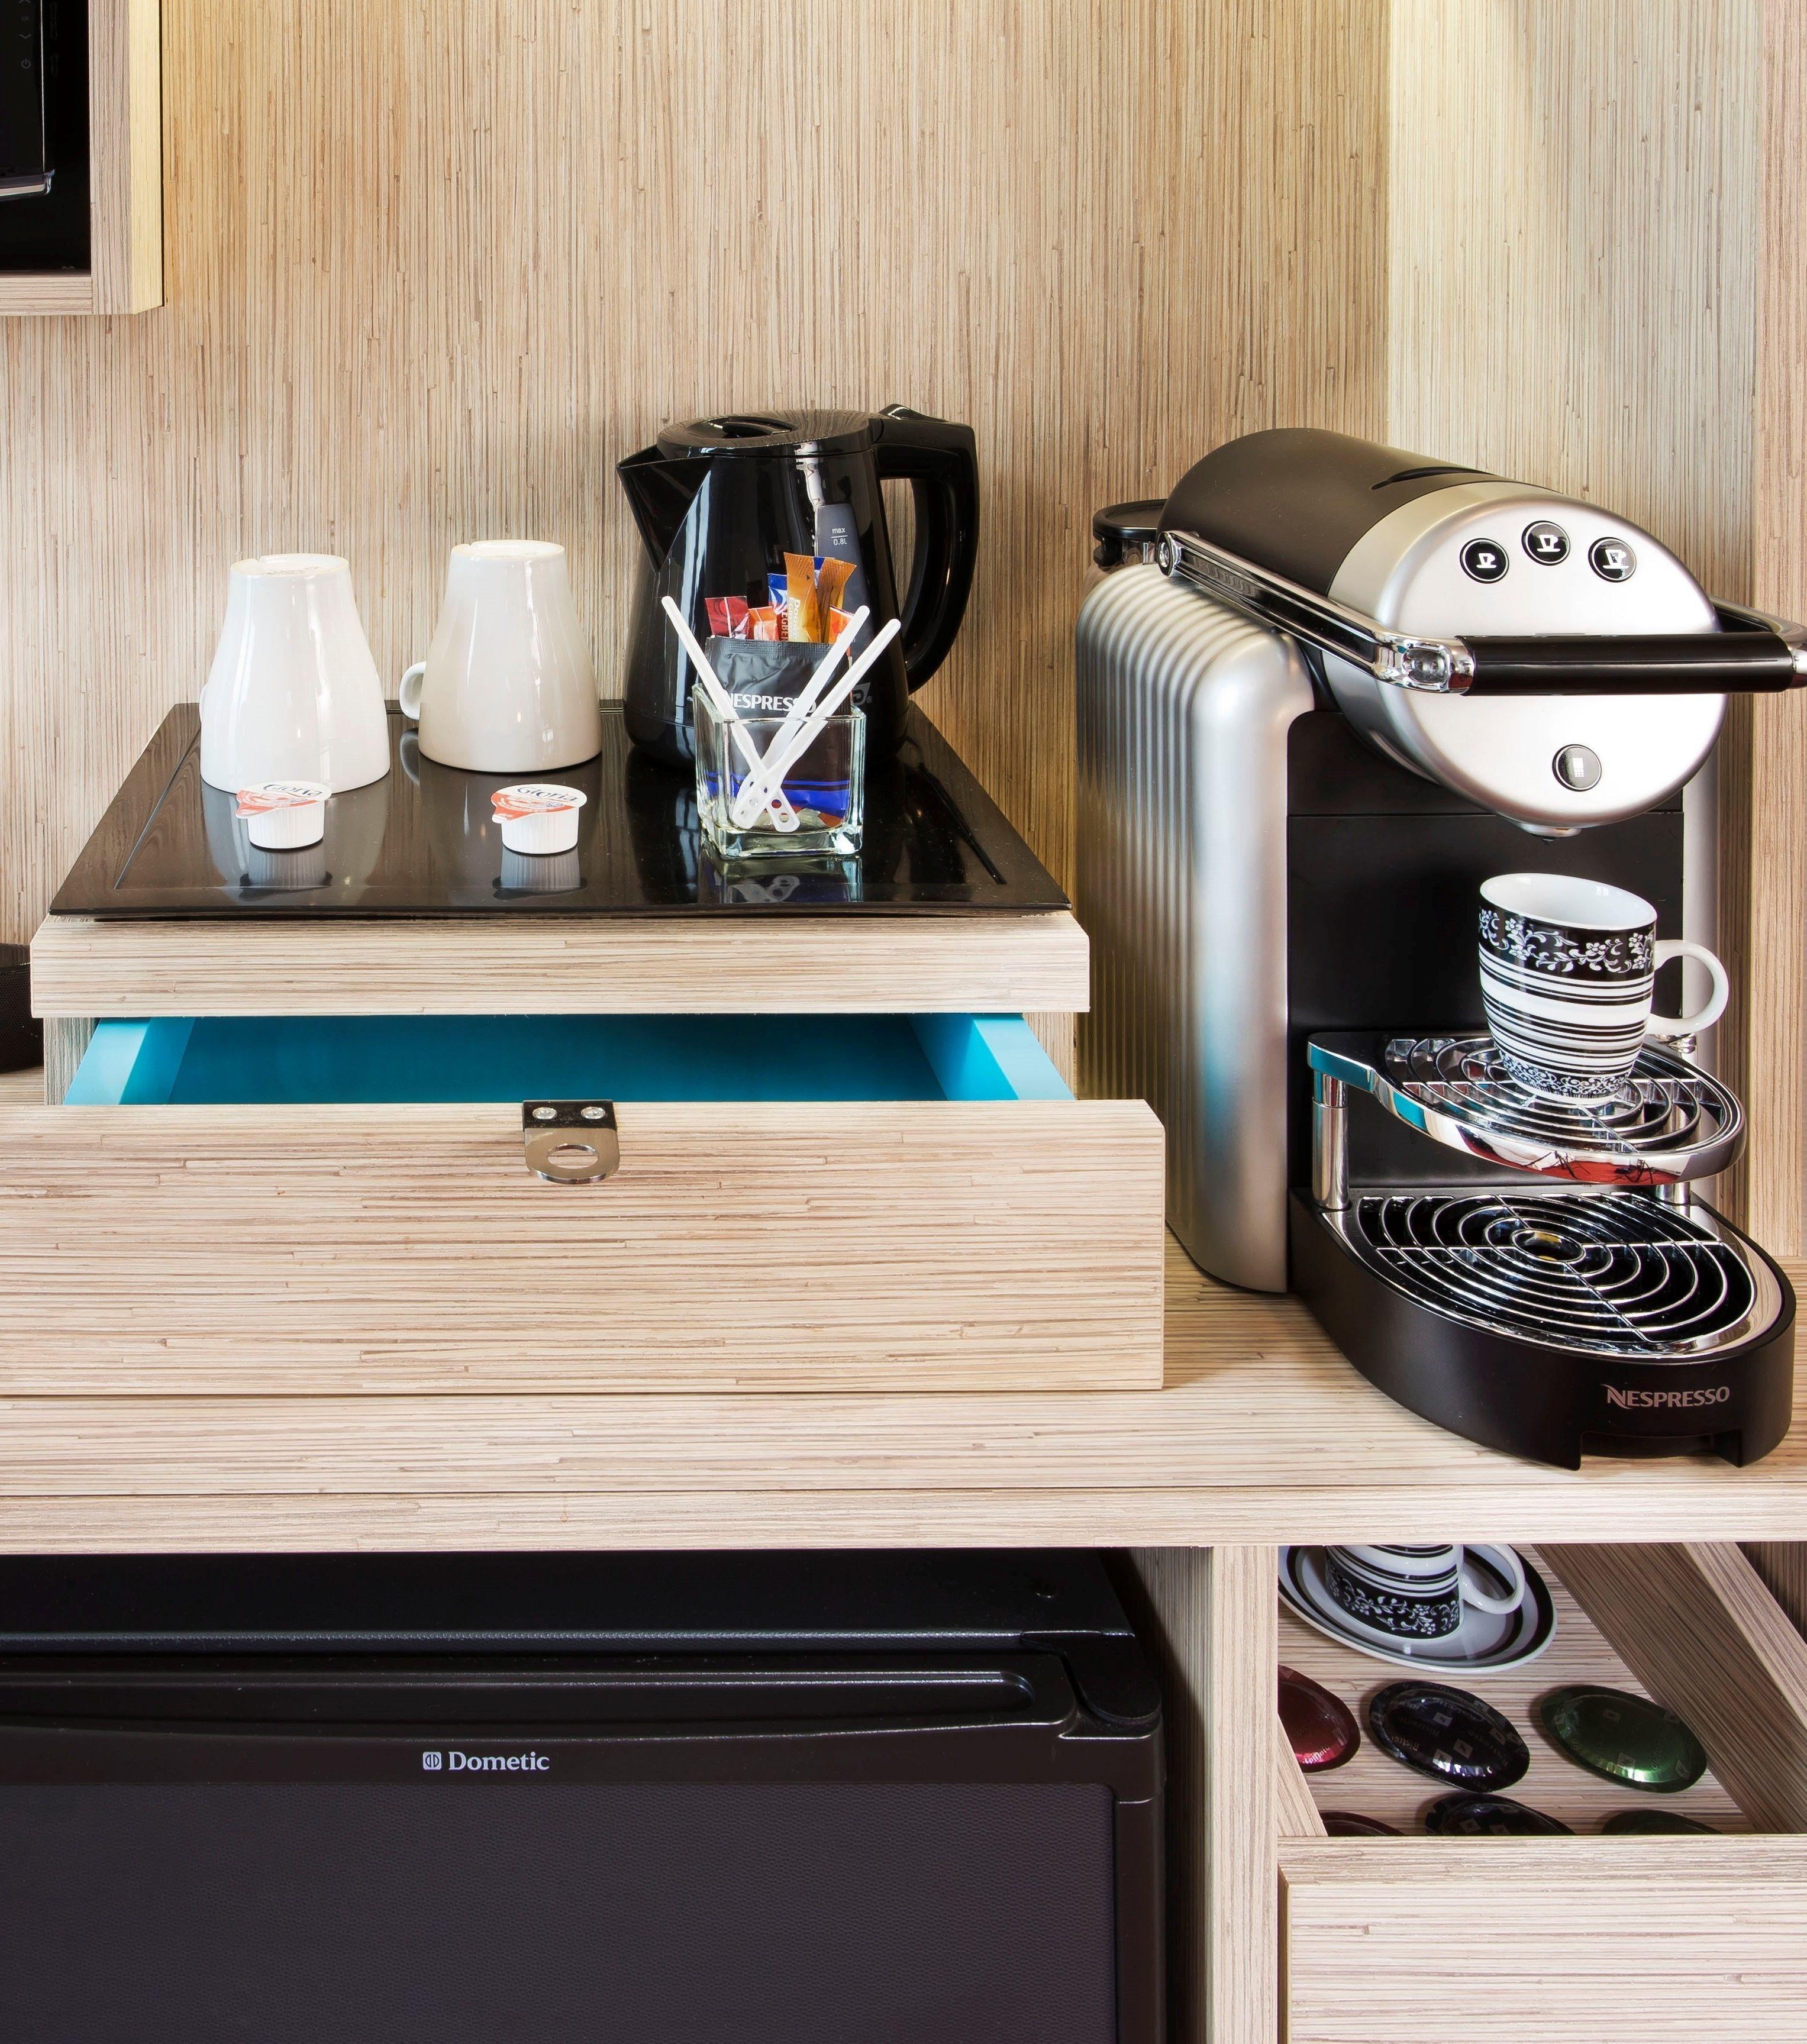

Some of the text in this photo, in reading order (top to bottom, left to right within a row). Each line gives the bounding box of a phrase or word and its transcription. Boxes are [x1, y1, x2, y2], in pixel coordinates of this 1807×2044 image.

[730, 692, 817, 713] ESPRES
[517, 786, 578, 801] Gloria
[1601, 1384, 1729, 1409] NESPRESSO
[448, 1751, 550, 1770] Dometic
